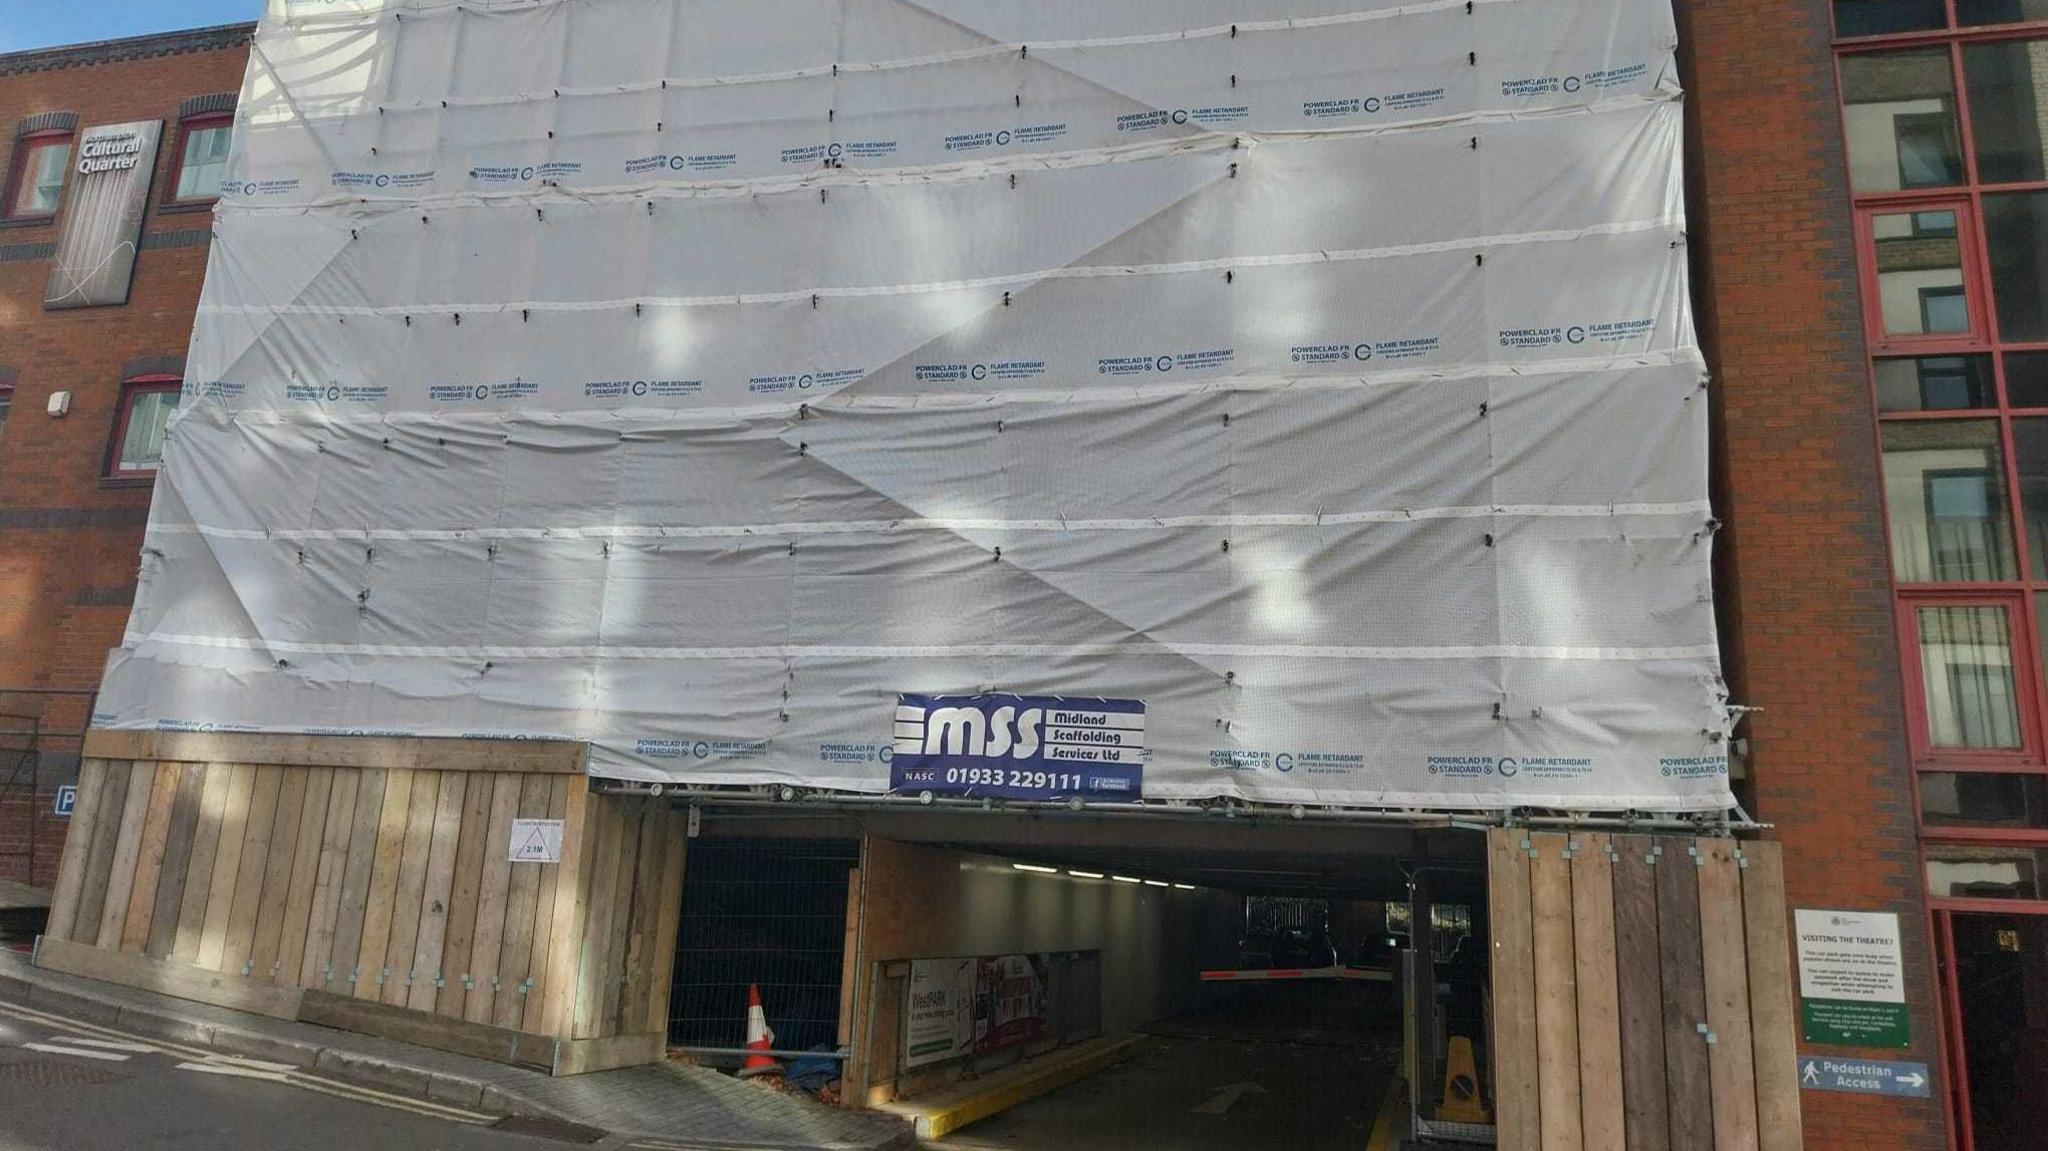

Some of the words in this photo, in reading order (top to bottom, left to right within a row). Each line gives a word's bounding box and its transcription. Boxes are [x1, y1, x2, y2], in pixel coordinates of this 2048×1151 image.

[1585, 72, 1606, 80] FLAME
[1607, 64, 1646, 76] RETARDANT
[1502, 79, 1547, 87] POWERCLAD
[1512, 85, 1549, 93] STANDARD
[1385, 93, 1405, 101] FLAME
[1405, 89, 1444, 99] RETARDANT
[1304, 100, 1349, 109] POWERCLAD
[1313, 106, 1350, 114] STANDARD
[1117, 112, 1159, 122] POWERCLAD
[1125, 118, 1160, 128] STANDARD
[1031, 124, 1067, 133] RETARDANT
[945, 133, 984, 143] POWERCLAD
[83, 137, 141, 158] Cultural
[864, 141, 898, 149] RETARDANT
[953, 138, 985, 148] STANDARD
[782, 147, 820, 156] POWERCLAD
[789, 152, 819, 160] STANDARD
[79, 158, 137, 174] Quarter
[1589, 323, 1613, 332] FLAME
[1613, 319, 1655, 329] RETARDANT
[1500, 330, 1550, 338] POWERCLAD
[1376, 341, 1399, 349] FLAME
[1399, 337, 1438, 347] RETARDANT
[1509, 336, 1551, 344] STANDARD
[1292, 345, 1340, 354] POWERCLAD
[1341, 344, 1350, 352] FR
[1177, 353, 1197, 361] FLAME
[1198, 349, 1234, 358] RETARDANT
[1301, 353, 1340, 361] STANDARD
[1099, 358, 1142, 366] POWERCLAD
[835, 368, 865, 377] RETARDANT
[1108, 364, 1143, 373] STANDARD
[757, 382, 788, 391] STANDARD
[1054, 712, 1106, 725] Midland
[1053, 732, 1121, 745] Scaffolding
[821, 744, 865, 752] POWERCLAD
[829, 752, 866, 760] STANDARD
[1052, 749, 1100, 760] Services
[1103, 750, 1120, 761] Ltd
[1298, 753, 1321, 761] FLAME
[1322, 754, 1364, 762] RETARDANT
[1221, 760, 1260, 768] STANDARD
[1549, 758, 1592, 766] RETARDANT
[1660, 758, 1715, 766] POWERCLAD
[1439, 766, 1482, 774] STANDARD
[1672, 767, 1717, 775] STANDARD
[906, 772, 934, 781] NASC
[946, 768, 1005, 785] 01933
[1009, 770, 1081, 790] 229111
[62, 791, 75, 810] P
[527, 845, 543, 853] 2.1M
[1801, 935, 1838, 943] VISITING
[1839, 936, 1854, 944] THE
[1856, 937, 1894, 946] THEATRE?
[912, 990, 948, 1009] WestPARK
[1824, 1061, 1892, 1077] Pedestrian
[1837, 1077, 1881, 1089] Access
